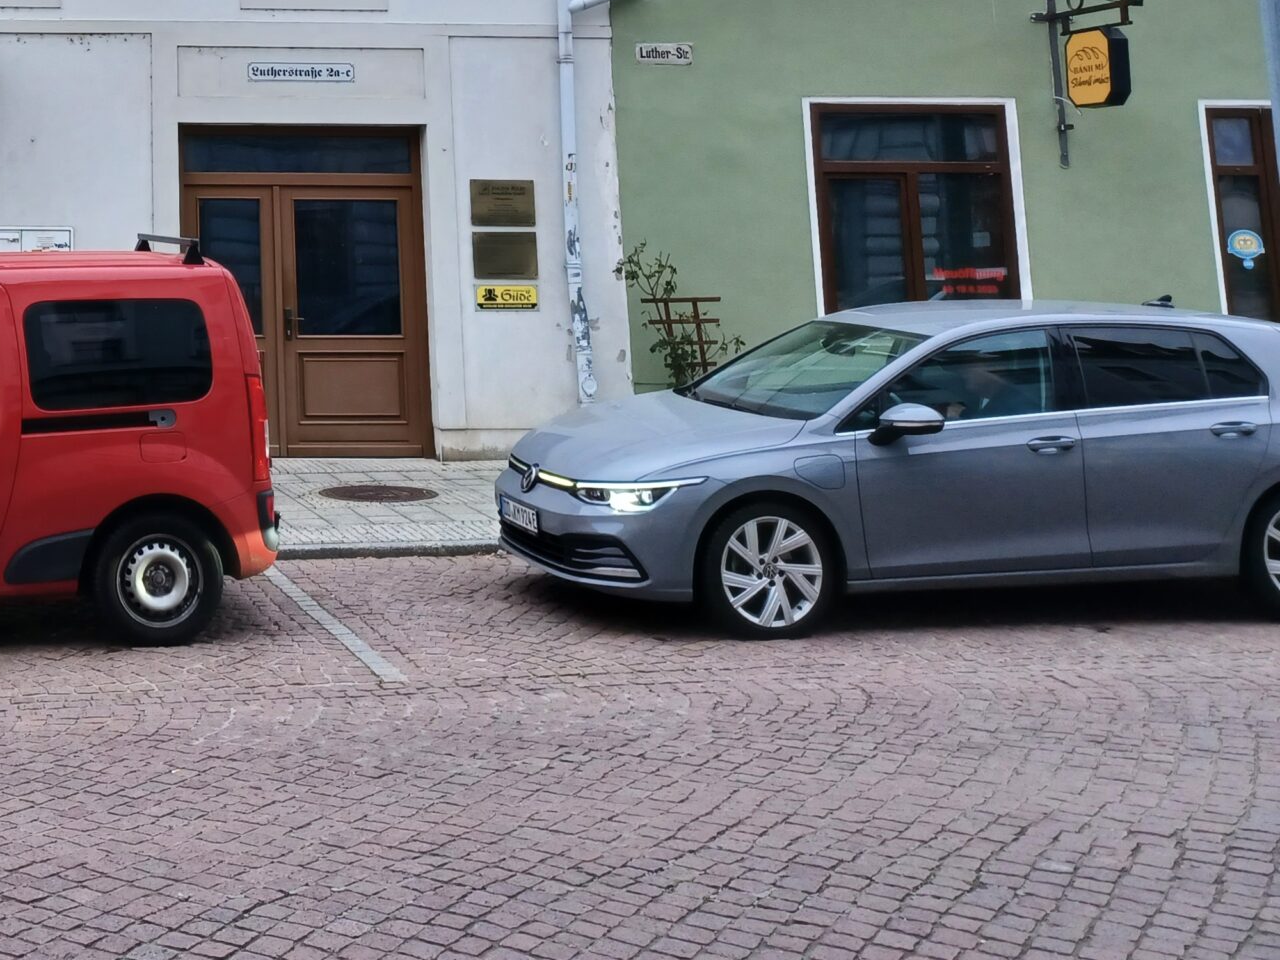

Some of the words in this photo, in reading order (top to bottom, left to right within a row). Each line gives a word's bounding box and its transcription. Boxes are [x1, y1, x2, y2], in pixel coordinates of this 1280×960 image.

[639, 46, 690, 60] Luther-Str.
[251, 66, 323, 79] Lutherstraße
[326, 67, 351, 78] 2a-c
[500, 288, 532, 302] Gilde
